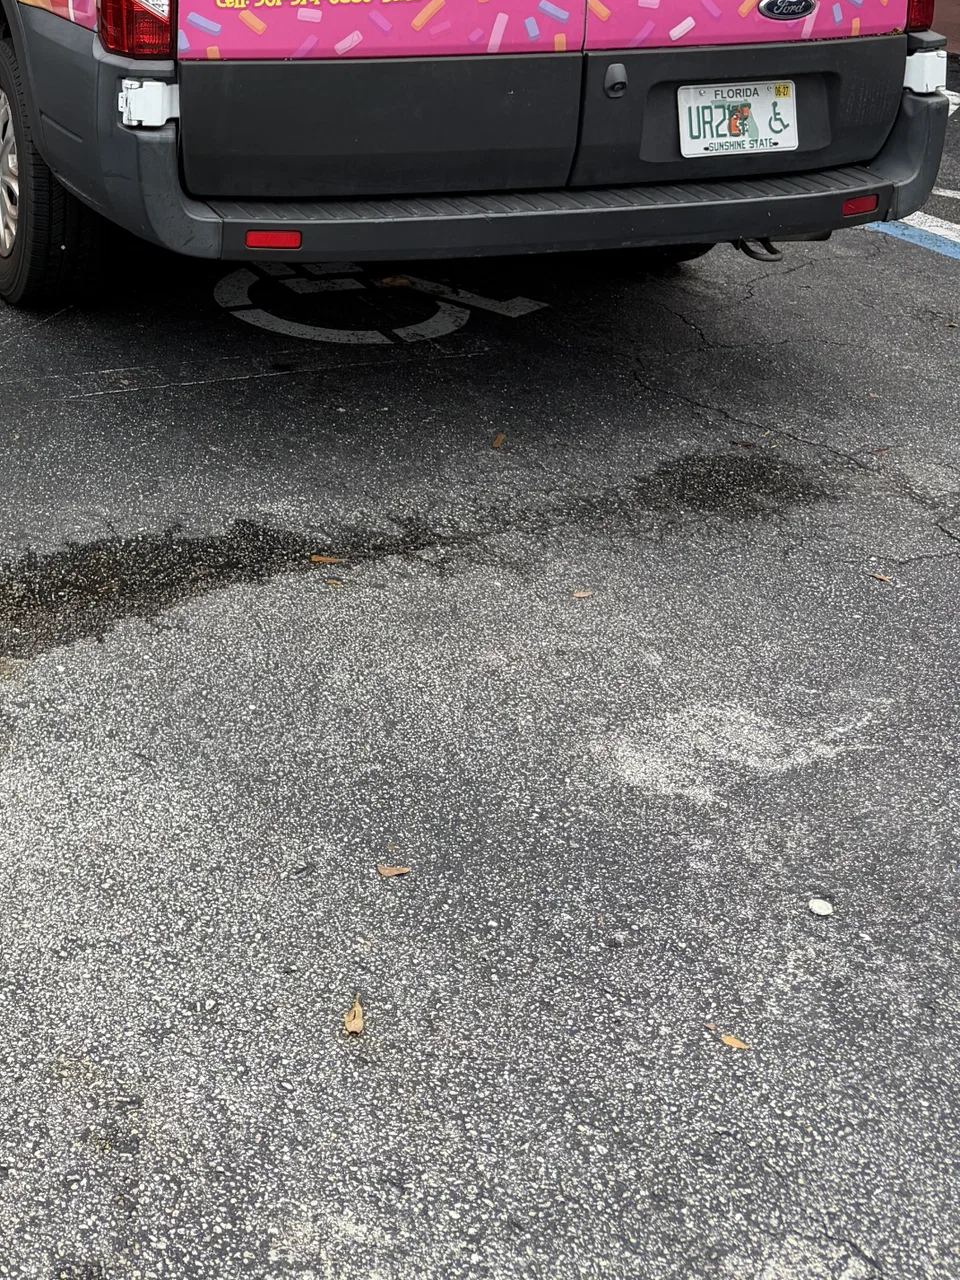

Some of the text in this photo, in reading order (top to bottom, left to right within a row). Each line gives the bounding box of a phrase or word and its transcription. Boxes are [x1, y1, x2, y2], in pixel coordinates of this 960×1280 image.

[714, 87, 760, 100] FLORIDA
[708, 137, 774, 152] SUNSHINE STATE
